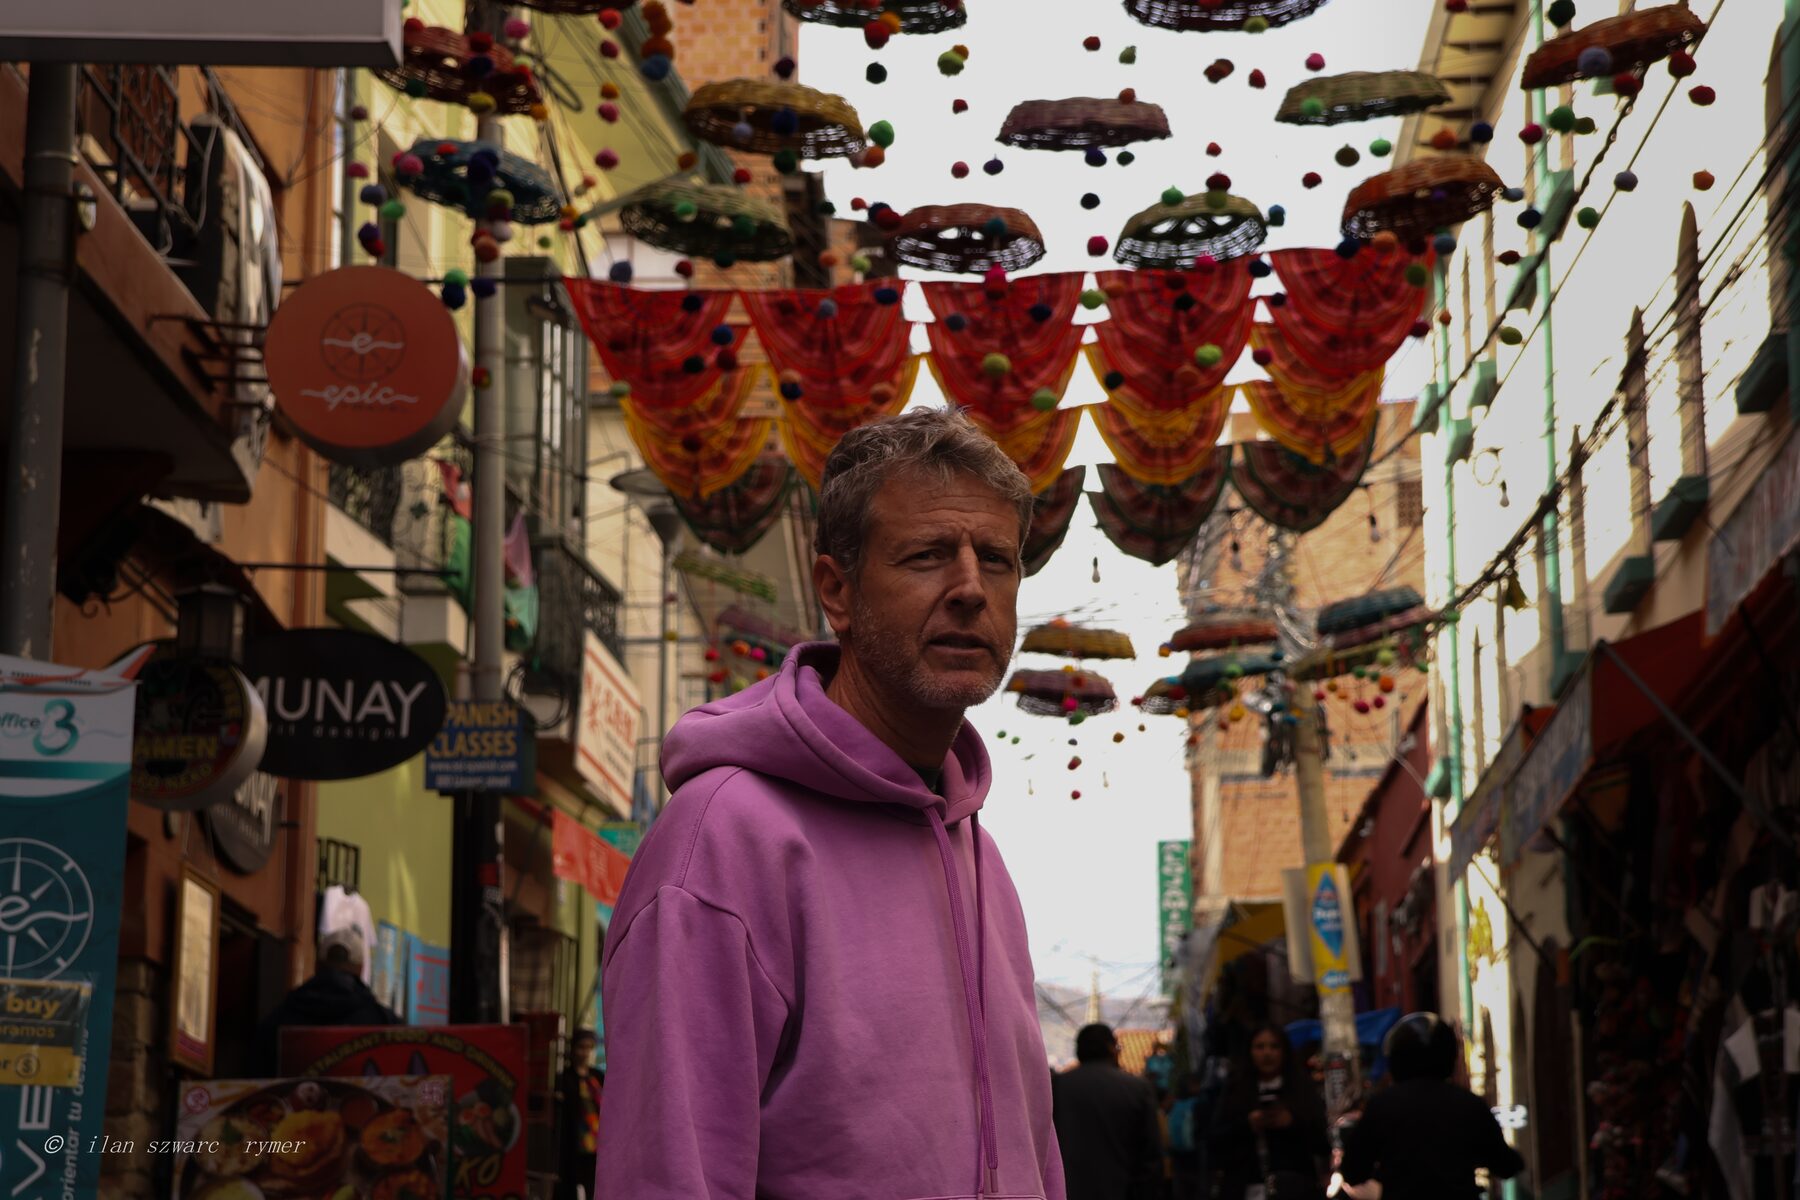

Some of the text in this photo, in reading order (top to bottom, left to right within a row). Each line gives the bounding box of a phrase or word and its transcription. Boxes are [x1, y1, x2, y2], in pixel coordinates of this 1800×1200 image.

[300, 382, 419, 411] epic
[0, 698, 79, 757] ffice 3
[442, 703, 519, 728] PANISH
[134, 736, 218, 760] AMEN
[427, 731, 518, 759] CLASSES
[6, 990, 61, 1020] buy
[0, 1025, 56, 1039] ramos
[67, 1101, 83, 1121] tu
[453, 1150, 502, 1189] KO
